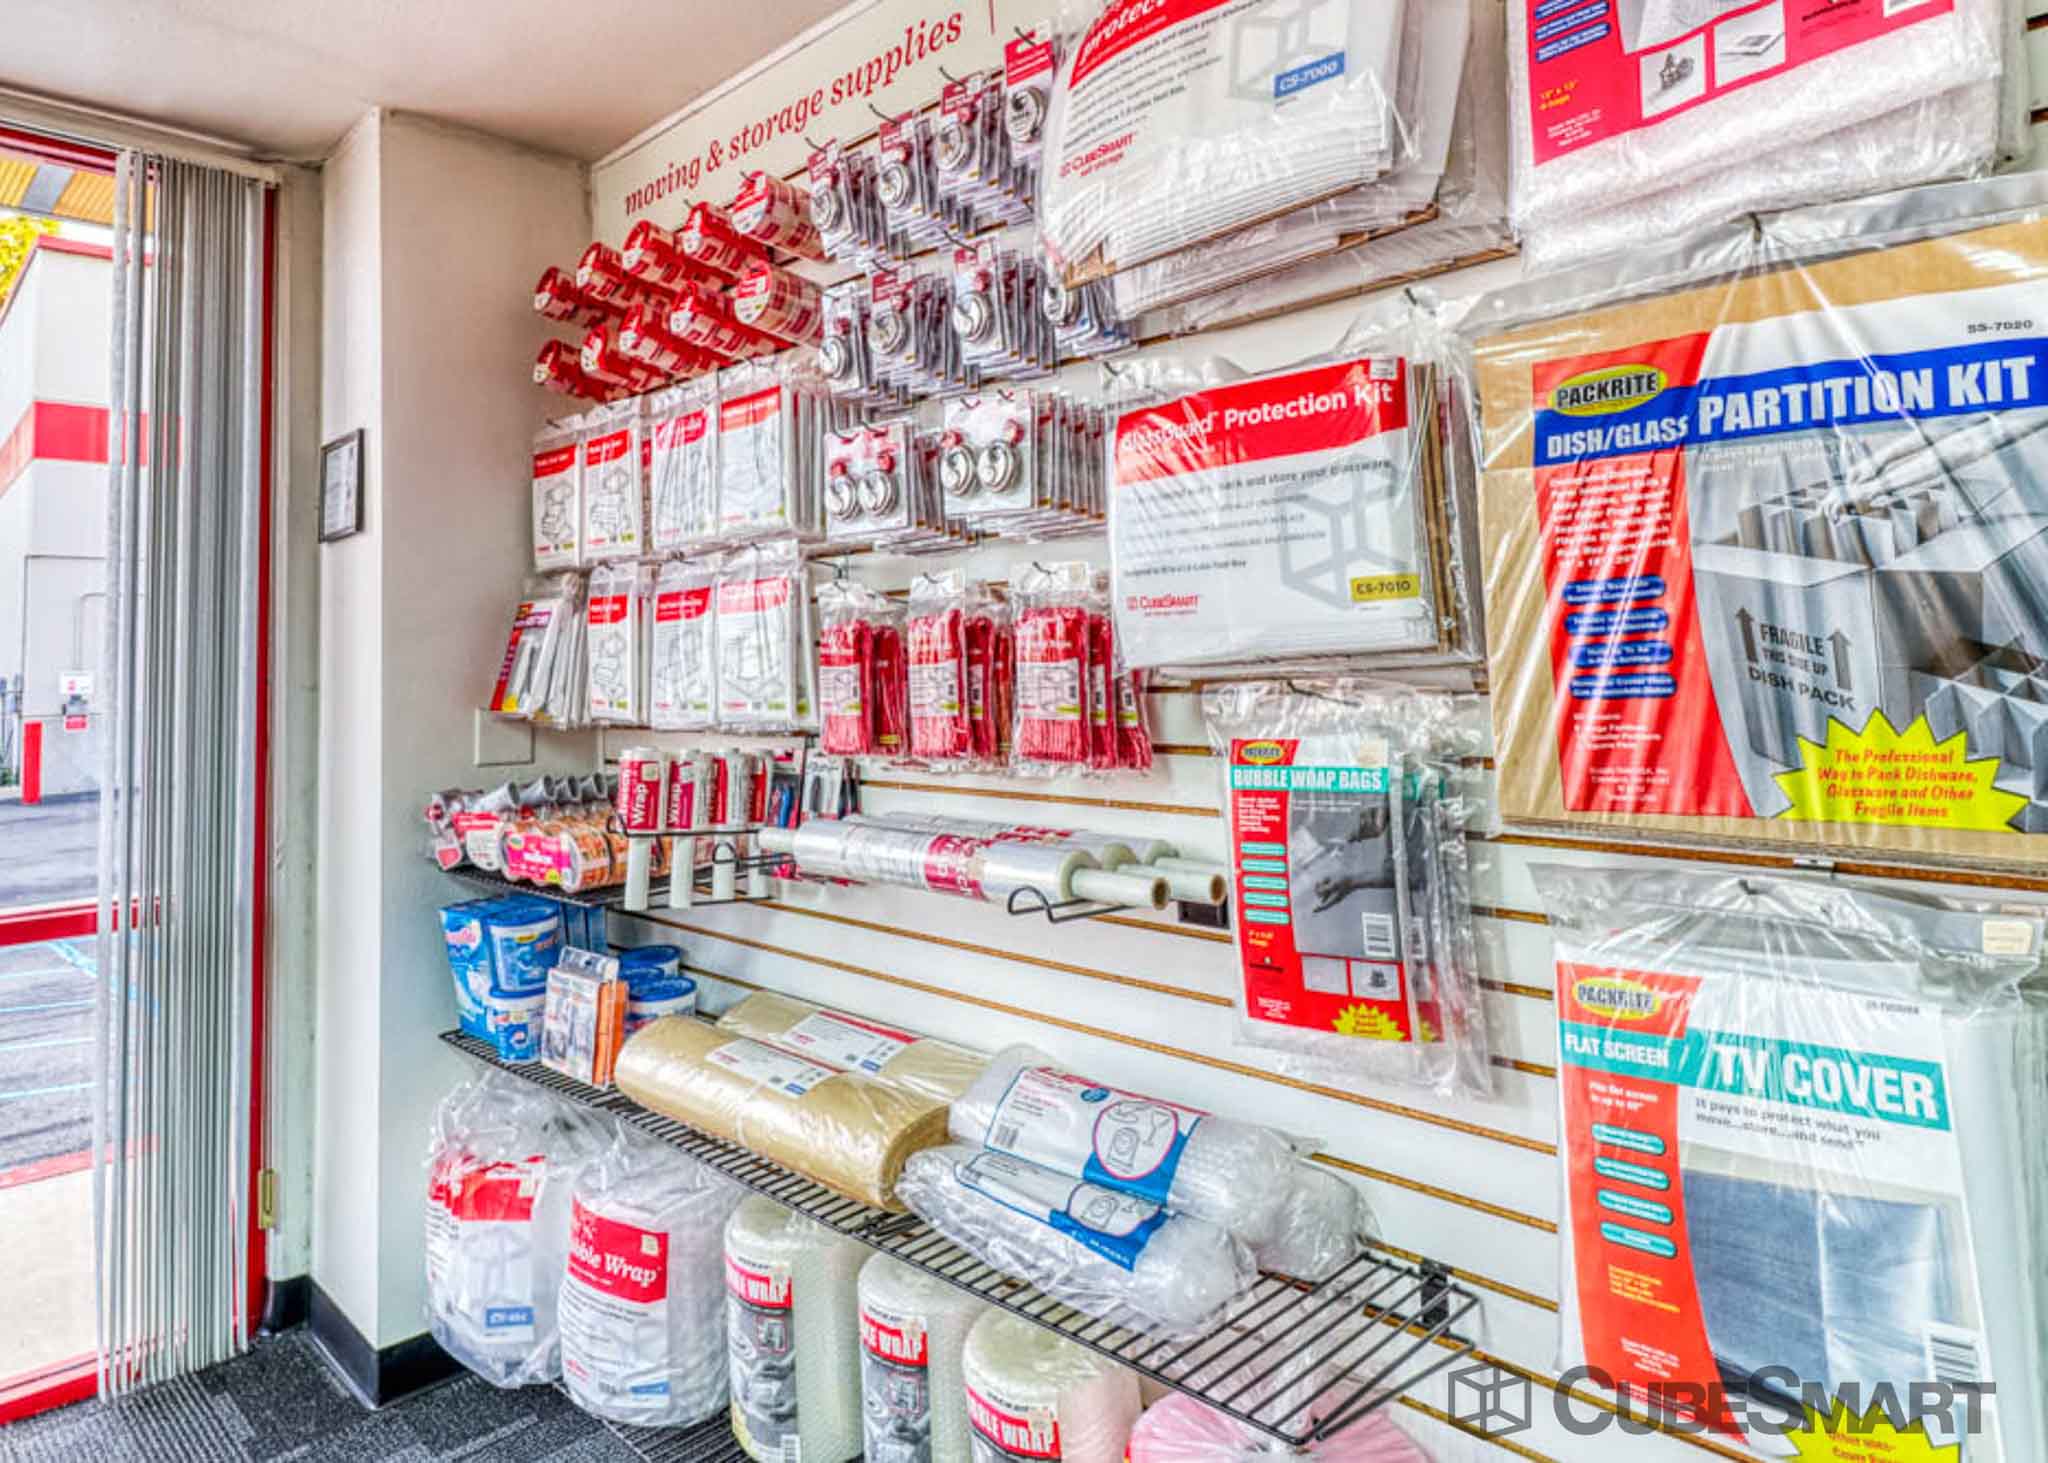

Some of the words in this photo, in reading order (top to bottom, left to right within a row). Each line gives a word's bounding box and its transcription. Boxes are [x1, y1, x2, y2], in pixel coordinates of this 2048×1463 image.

[624, 155, 701, 216] moving
[704, 139, 727, 172] &
[728, 88, 824, 162] storage
[829, 11, 964, 106] supplies
[1966, 319, 2034, 335] SS-7020
[1224, 389, 1347, 431] Protection
[1354, 381, 1394, 406] Kit
[1556, 371, 1659, 408] PACKRITE
[1546, 415, 1690, 460] DISH/GLASS
[1699, 367, 1935, 434] PARTITION
[1947, 356, 2036, 408] KIT
[1356, 580, 1411, 595] CS-7010
[1760, 623, 1825, 657] FRAGILE
[1811, 661, 1828, 677] UP
[1749, 665, 1795, 692] DISH
[1799, 682, 1856, 711] PACK
[1818, 766, 1850, 783] Way
[1851, 767, 1865, 781] to
[1866, 766, 1901, 781] Pack
[1835, 749, 1860, 763] The
[1863, 749, 1955, 765] Professional
[1234, 768, 1288, 788] BUBBLE
[1291, 770, 1337, 789] WRAP
[1339, 771, 1382, 790] BAGS
[1826, 783, 1898, 801] Glassware
[1901, 784, 1929, 800] and
[1931, 784, 1974, 800] Other
[631, 783, 648, 826] Wrap
[1854, 801, 1905, 817] Fragile
[1907, 802, 1948, 817] Items
[1565, 1033, 1601, 1060] FLAT
[1603, 1042, 1670, 1069] SCREEN
[1713, 1044, 1770, 1094] TV
[1781, 1052, 1939, 1121] COVER
[1696, 1097, 1707, 1109] It
[1709, 1101, 1740, 1117] pays
[1743, 1106, 1757, 1118] to
[1760, 1110, 1811, 1127] protect
[1816, 1118, 1850, 1135] what
[1855, 1127, 1880, 1142] you
[604, 1252, 658, 1288] Wrap
